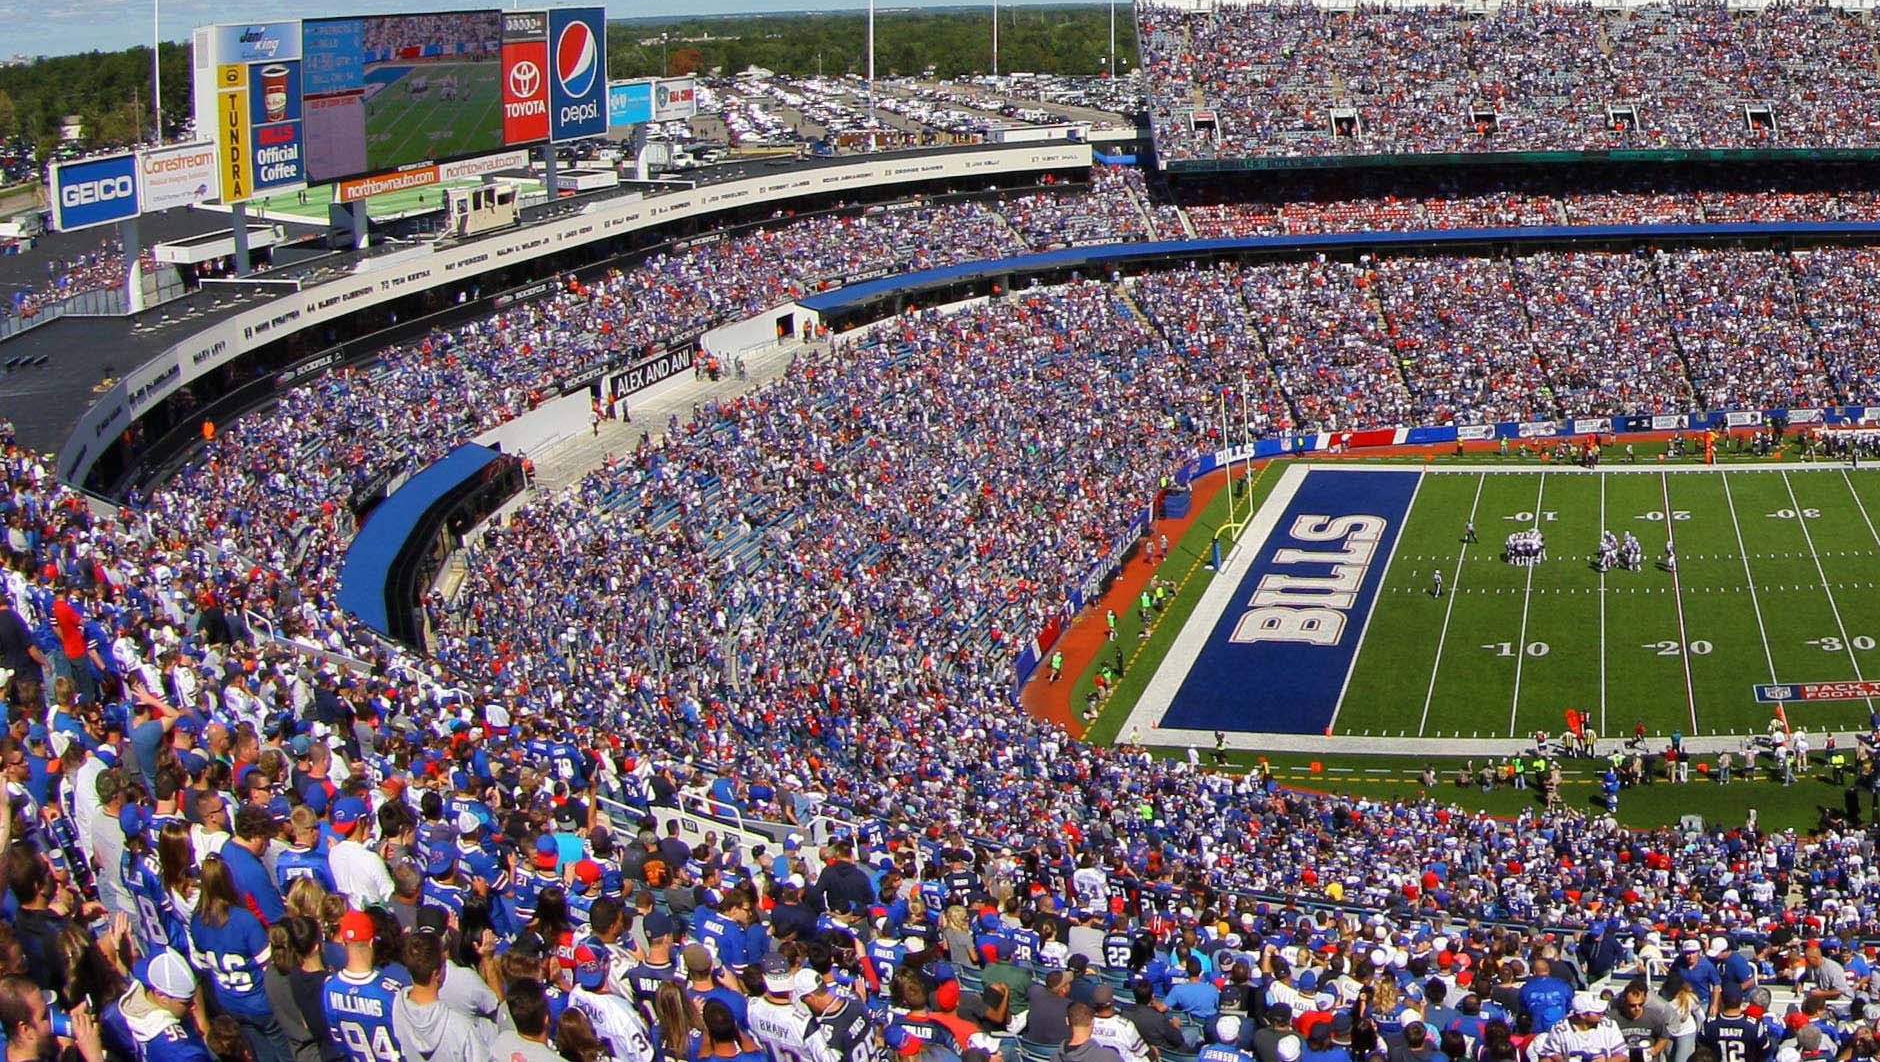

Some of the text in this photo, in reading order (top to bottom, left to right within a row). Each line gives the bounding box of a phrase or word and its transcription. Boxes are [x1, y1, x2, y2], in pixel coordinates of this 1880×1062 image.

[505, 100, 546, 118] TOYOTA
[561, 99, 597, 127] pepsi
[229, 94, 242, 197] TUNDRA
[258, 144, 298, 165] Official
[144, 152, 214, 175] Carestream
[260, 163, 297, 182] Coffee
[446, 153, 524, 178] northtownauto.com
[63, 175, 133, 208] GEICO
[347, 170, 435, 199] northtownauto.com
[617, 349, 691, 397] ALEX AND ANI
[1215, 442, 1255, 466] BILLS
[1228, 514, 1388, 646] BILLS
[1497, 642, 1549, 657] 10
[1657, 641, 1713, 656] 20
[1821, 636, 1876, 652] 30
[1804, 682, 1863, 693] BACK
[516, 873, 529, 887] 21
[923, 892, 942, 911] 13
[1107, 946, 1132, 966] 22
[878, 961, 895, 986] 3
[330, 991, 384, 1018] WILLIAMS
[760, 1019, 790, 1039] BRADY
[340, 1020, 401, 1062] 94
[1718, 1040, 1746, 1062] 12
